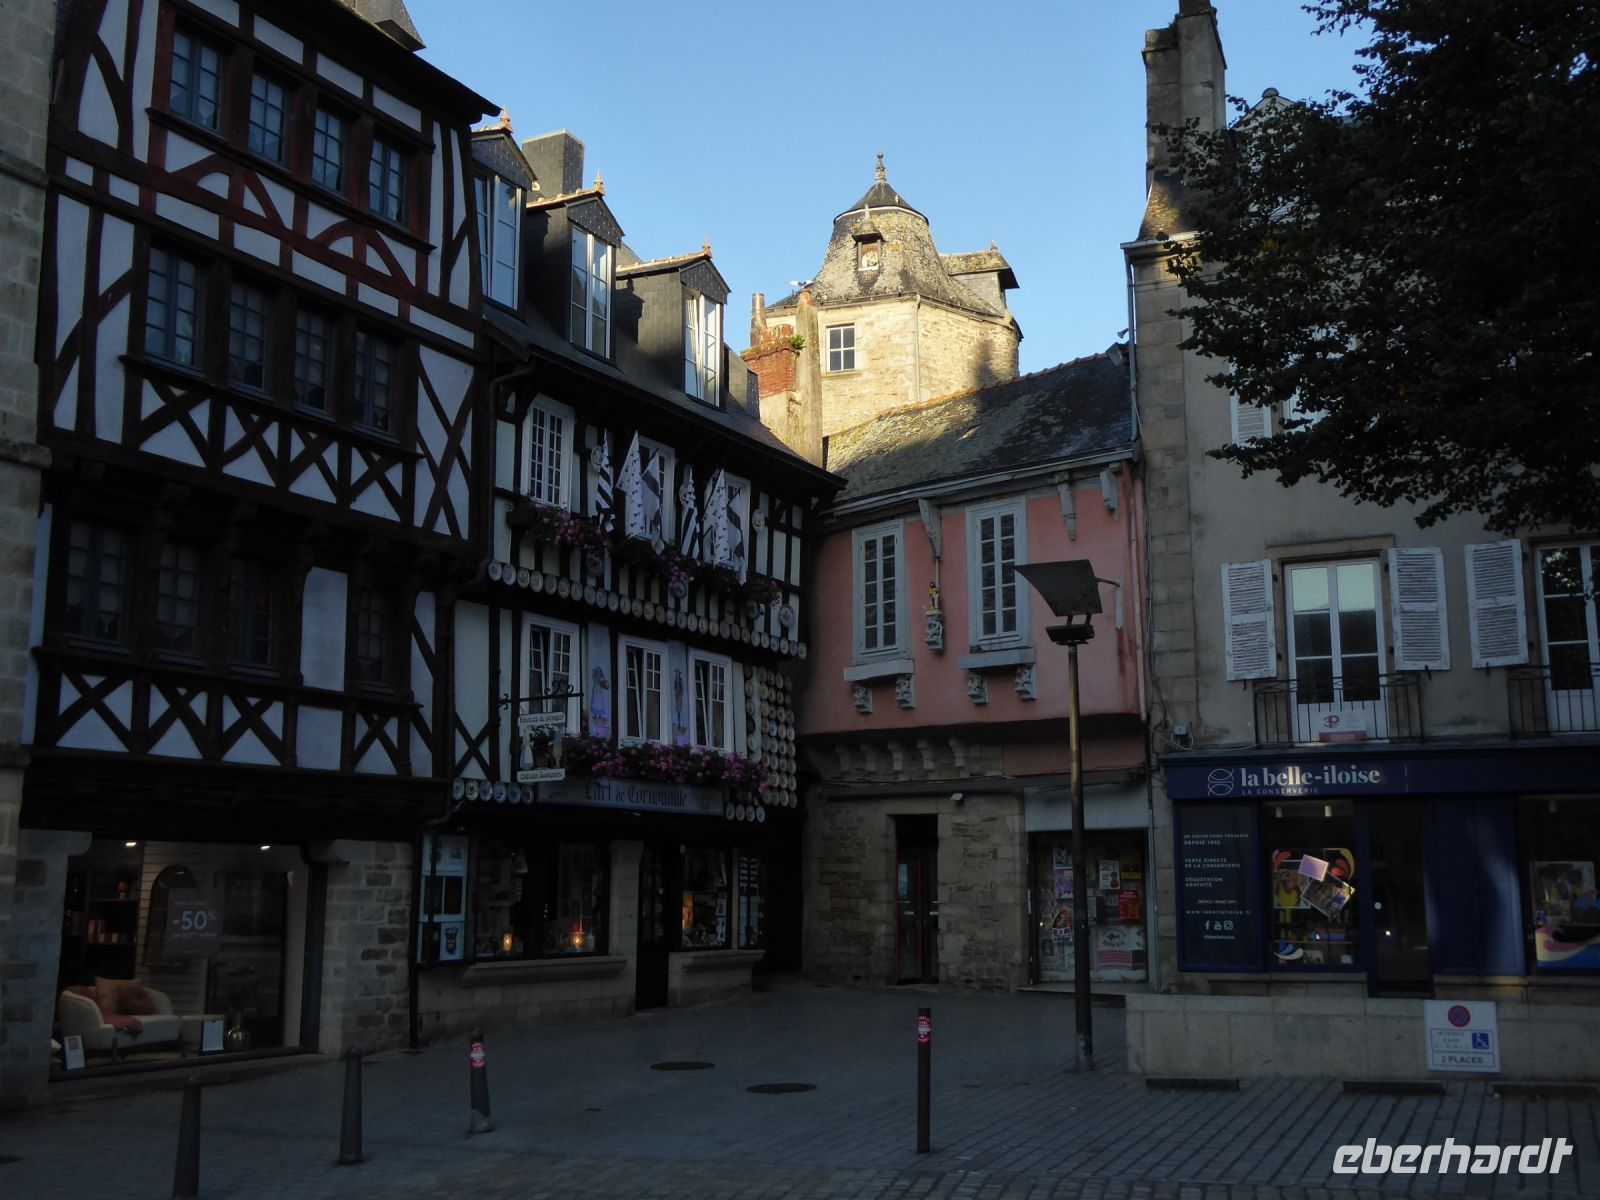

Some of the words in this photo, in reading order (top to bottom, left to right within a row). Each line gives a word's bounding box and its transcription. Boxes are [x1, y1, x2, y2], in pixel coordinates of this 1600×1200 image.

[1240, 767, 1260, 787] la
[1262, 764, 1381, 787] belle-iloise
[615, 786, 625, 803] de
[1257, 787, 1319, 796] CONSERVERIE
[1441, 1055, 1446, 1063] 2
[1448, 1055, 1484, 1064] PLACES
